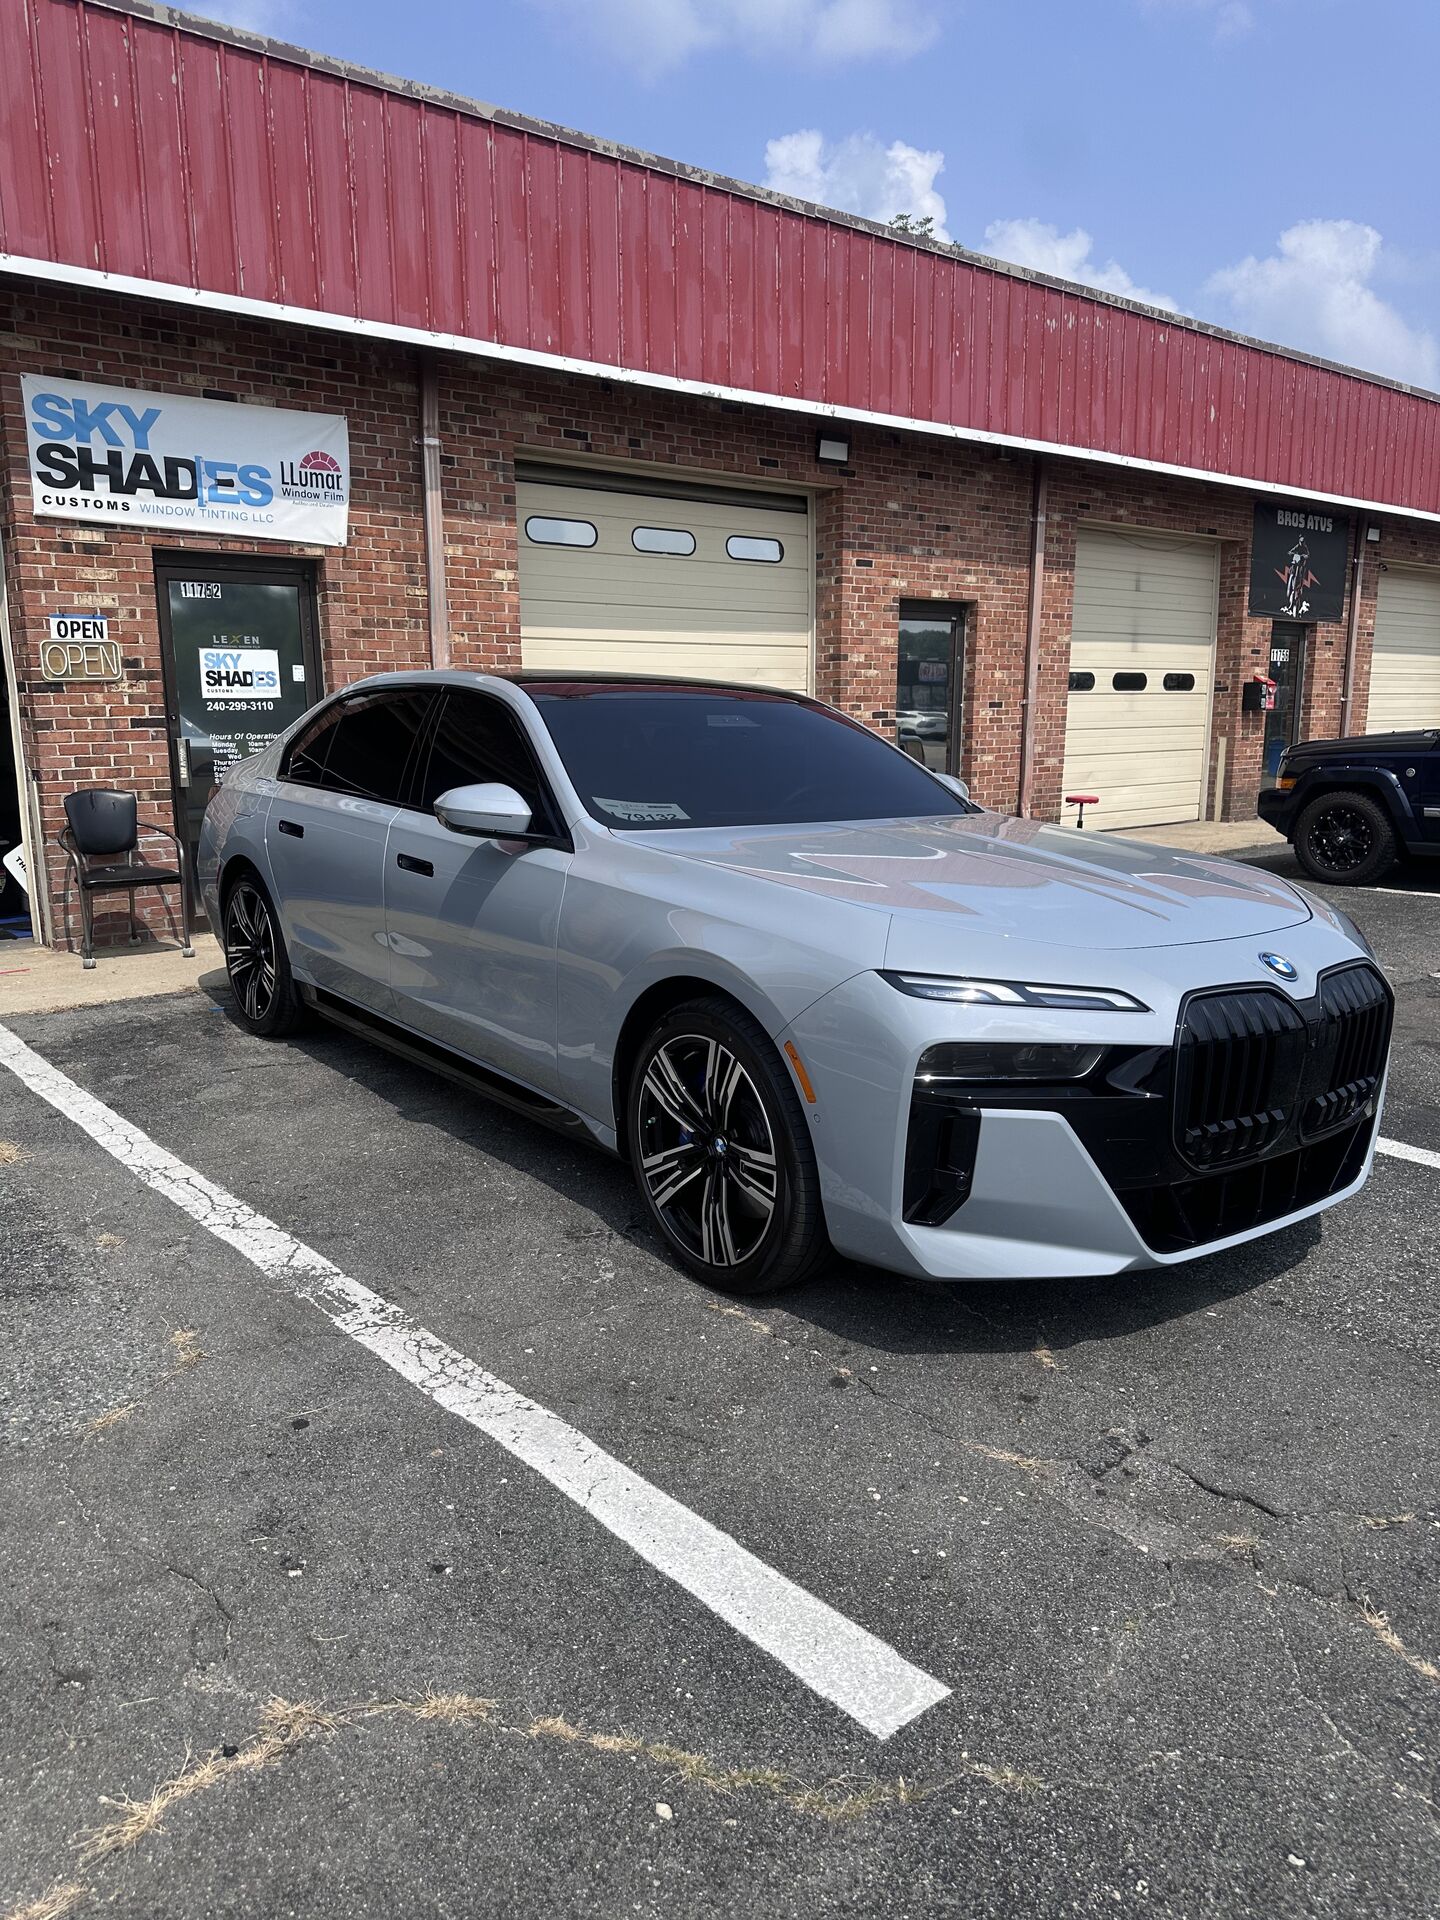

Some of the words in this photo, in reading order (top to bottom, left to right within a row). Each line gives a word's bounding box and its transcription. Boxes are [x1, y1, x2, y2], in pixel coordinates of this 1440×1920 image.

[31, 394, 162, 449] SKY
[35, 443, 274, 507] SHADES
[280, 460, 343, 491] LLumar
[281, 487, 321, 499] Window
[324, 491, 344, 501] Film
[42, 494, 131, 512] CUSTOMS
[139, 503, 196, 517] WINDOW
[199, 508, 249, 522] TINTING
[252, 513, 274, 523] LLC
[1277, 510, 1306, 528] BROS
[182, 583, 221, 598] 11752
[56, 620, 104, 639] OPEN
[212, 634, 260, 645] LEXEN
[46, 644, 118, 676] OPEN
[204, 652, 242, 670] SKY
[205, 669, 277, 688] SHADES
[206, 701, 274, 711] 240-299-3110
